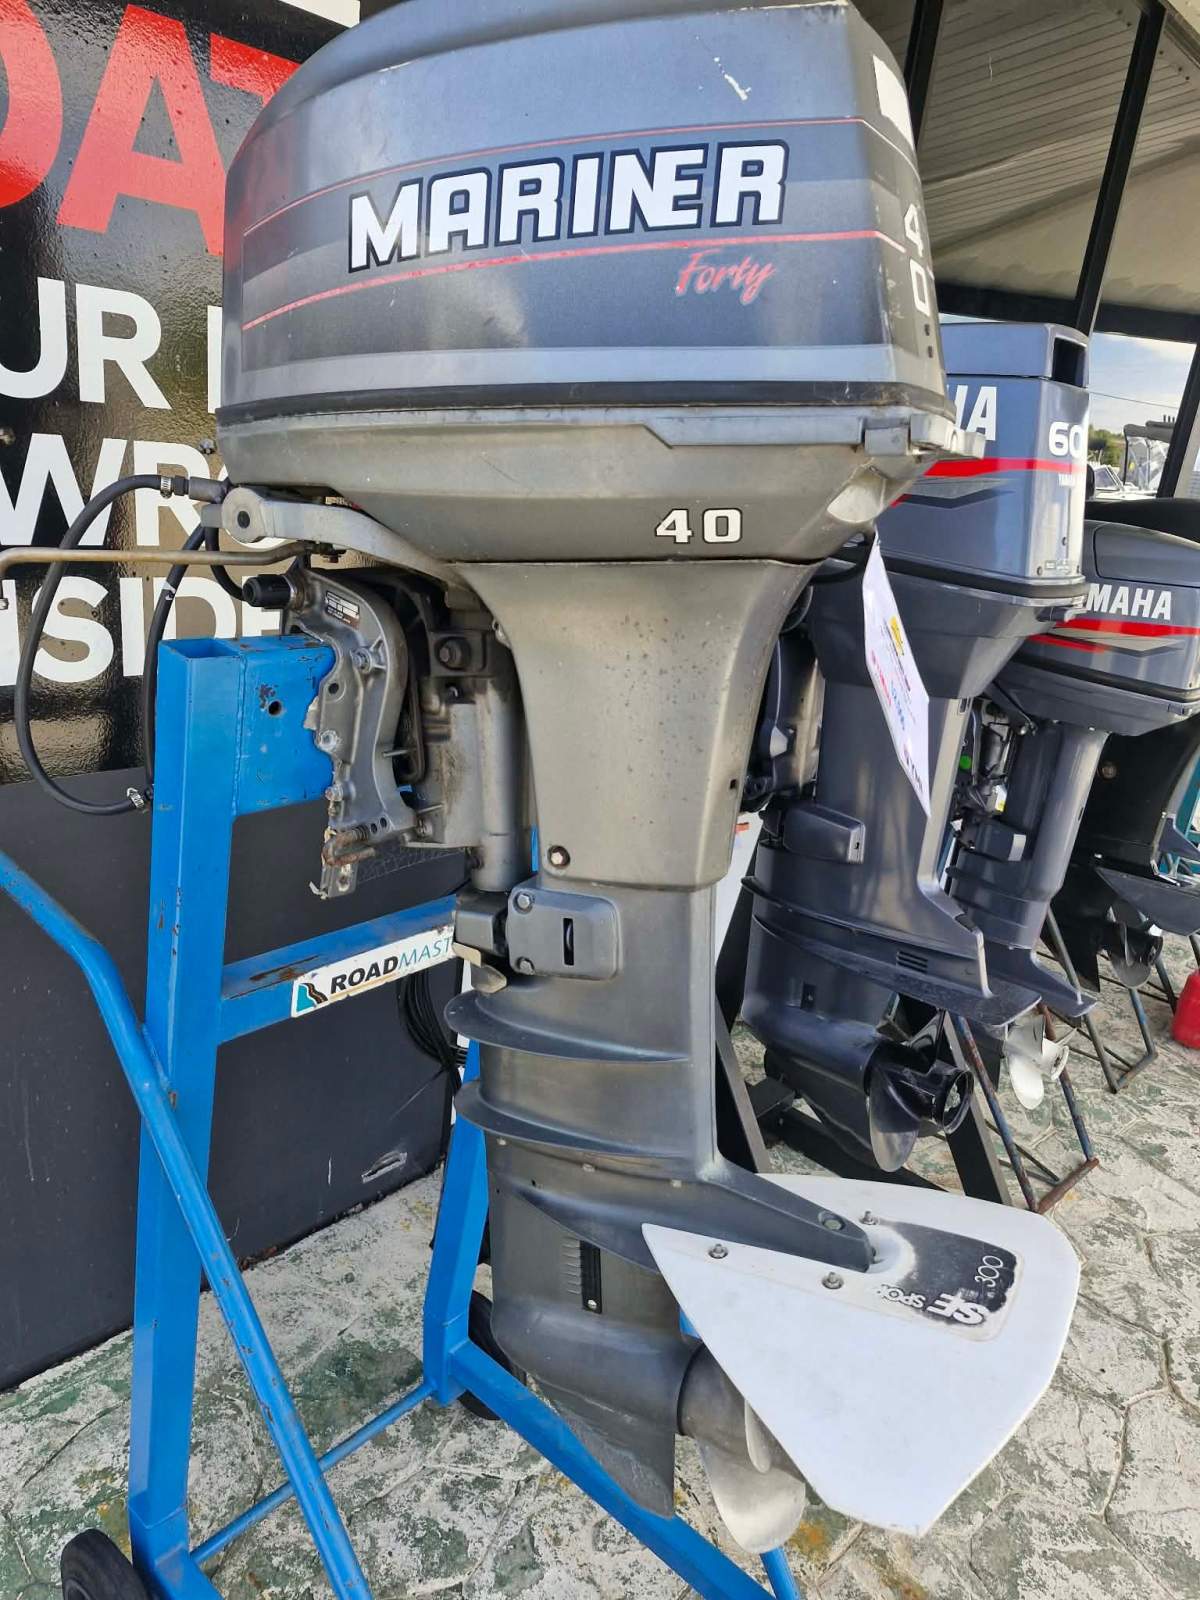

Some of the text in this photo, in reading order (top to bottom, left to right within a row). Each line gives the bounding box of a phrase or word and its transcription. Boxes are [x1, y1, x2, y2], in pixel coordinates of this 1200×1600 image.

[348, 139, 789, 273] MARINER
[675, 249, 777, 305] Forty
[1049, 421, 1084, 459] 60
[0, 433, 292, 549] WR
[655, 508, 742, 544] 40
[974, 1255, 1004, 1288] 300
